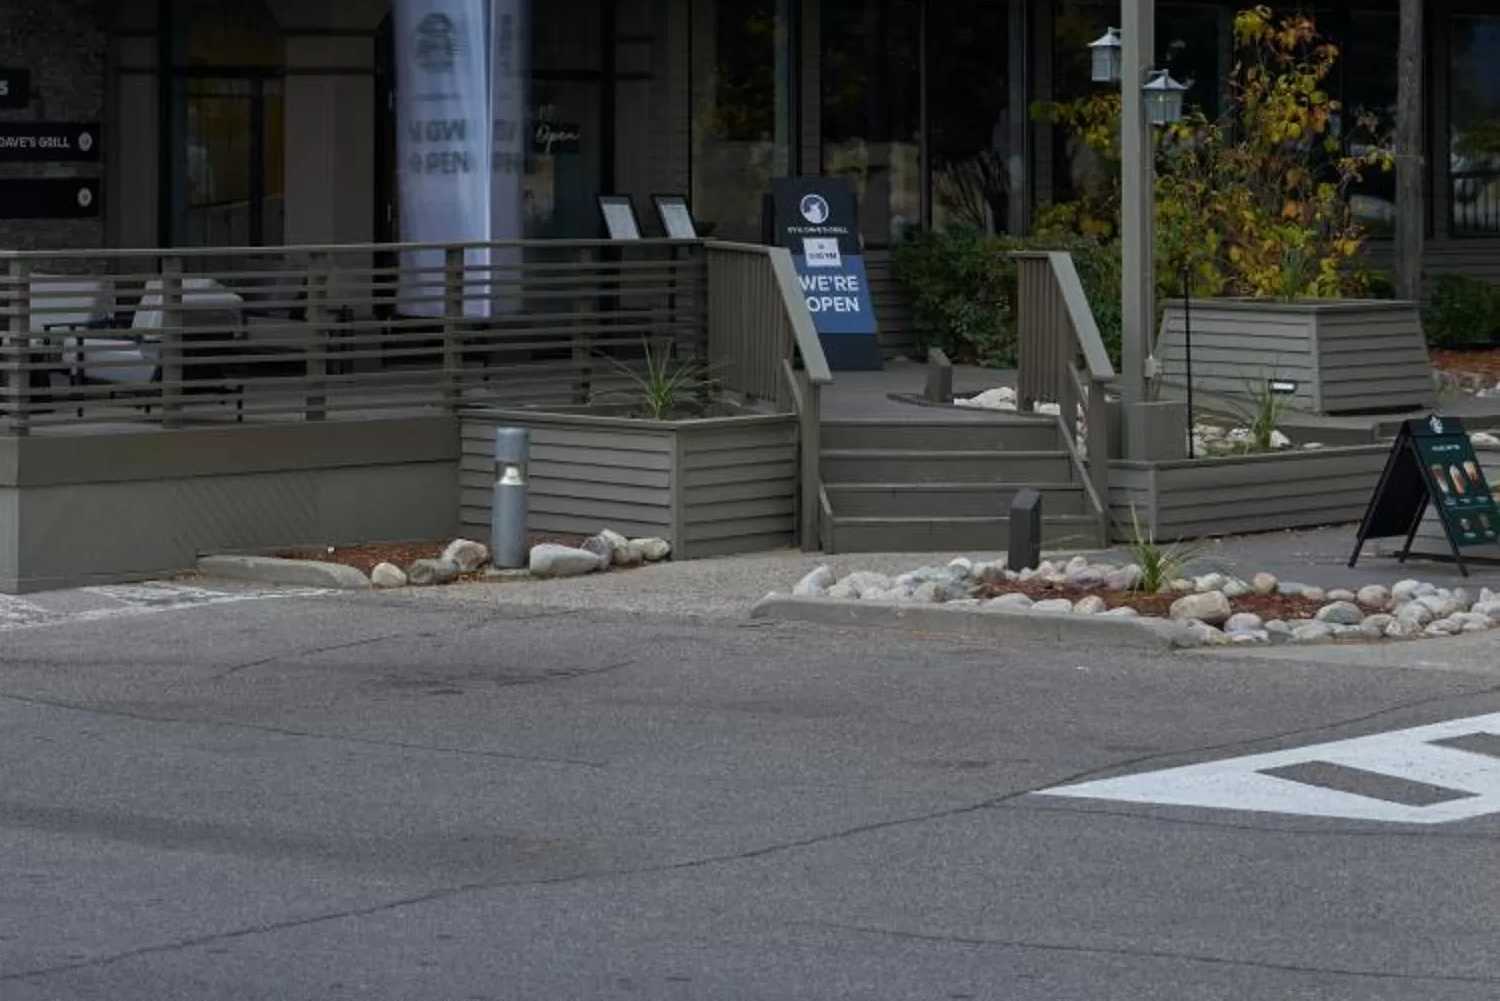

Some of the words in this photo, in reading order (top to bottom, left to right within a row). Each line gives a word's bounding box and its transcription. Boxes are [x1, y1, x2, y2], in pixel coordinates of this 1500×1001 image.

[38, 135, 71, 149] GRILL
[798, 274, 860, 292] WE'RE
[806, 295, 860, 312] OPEN
